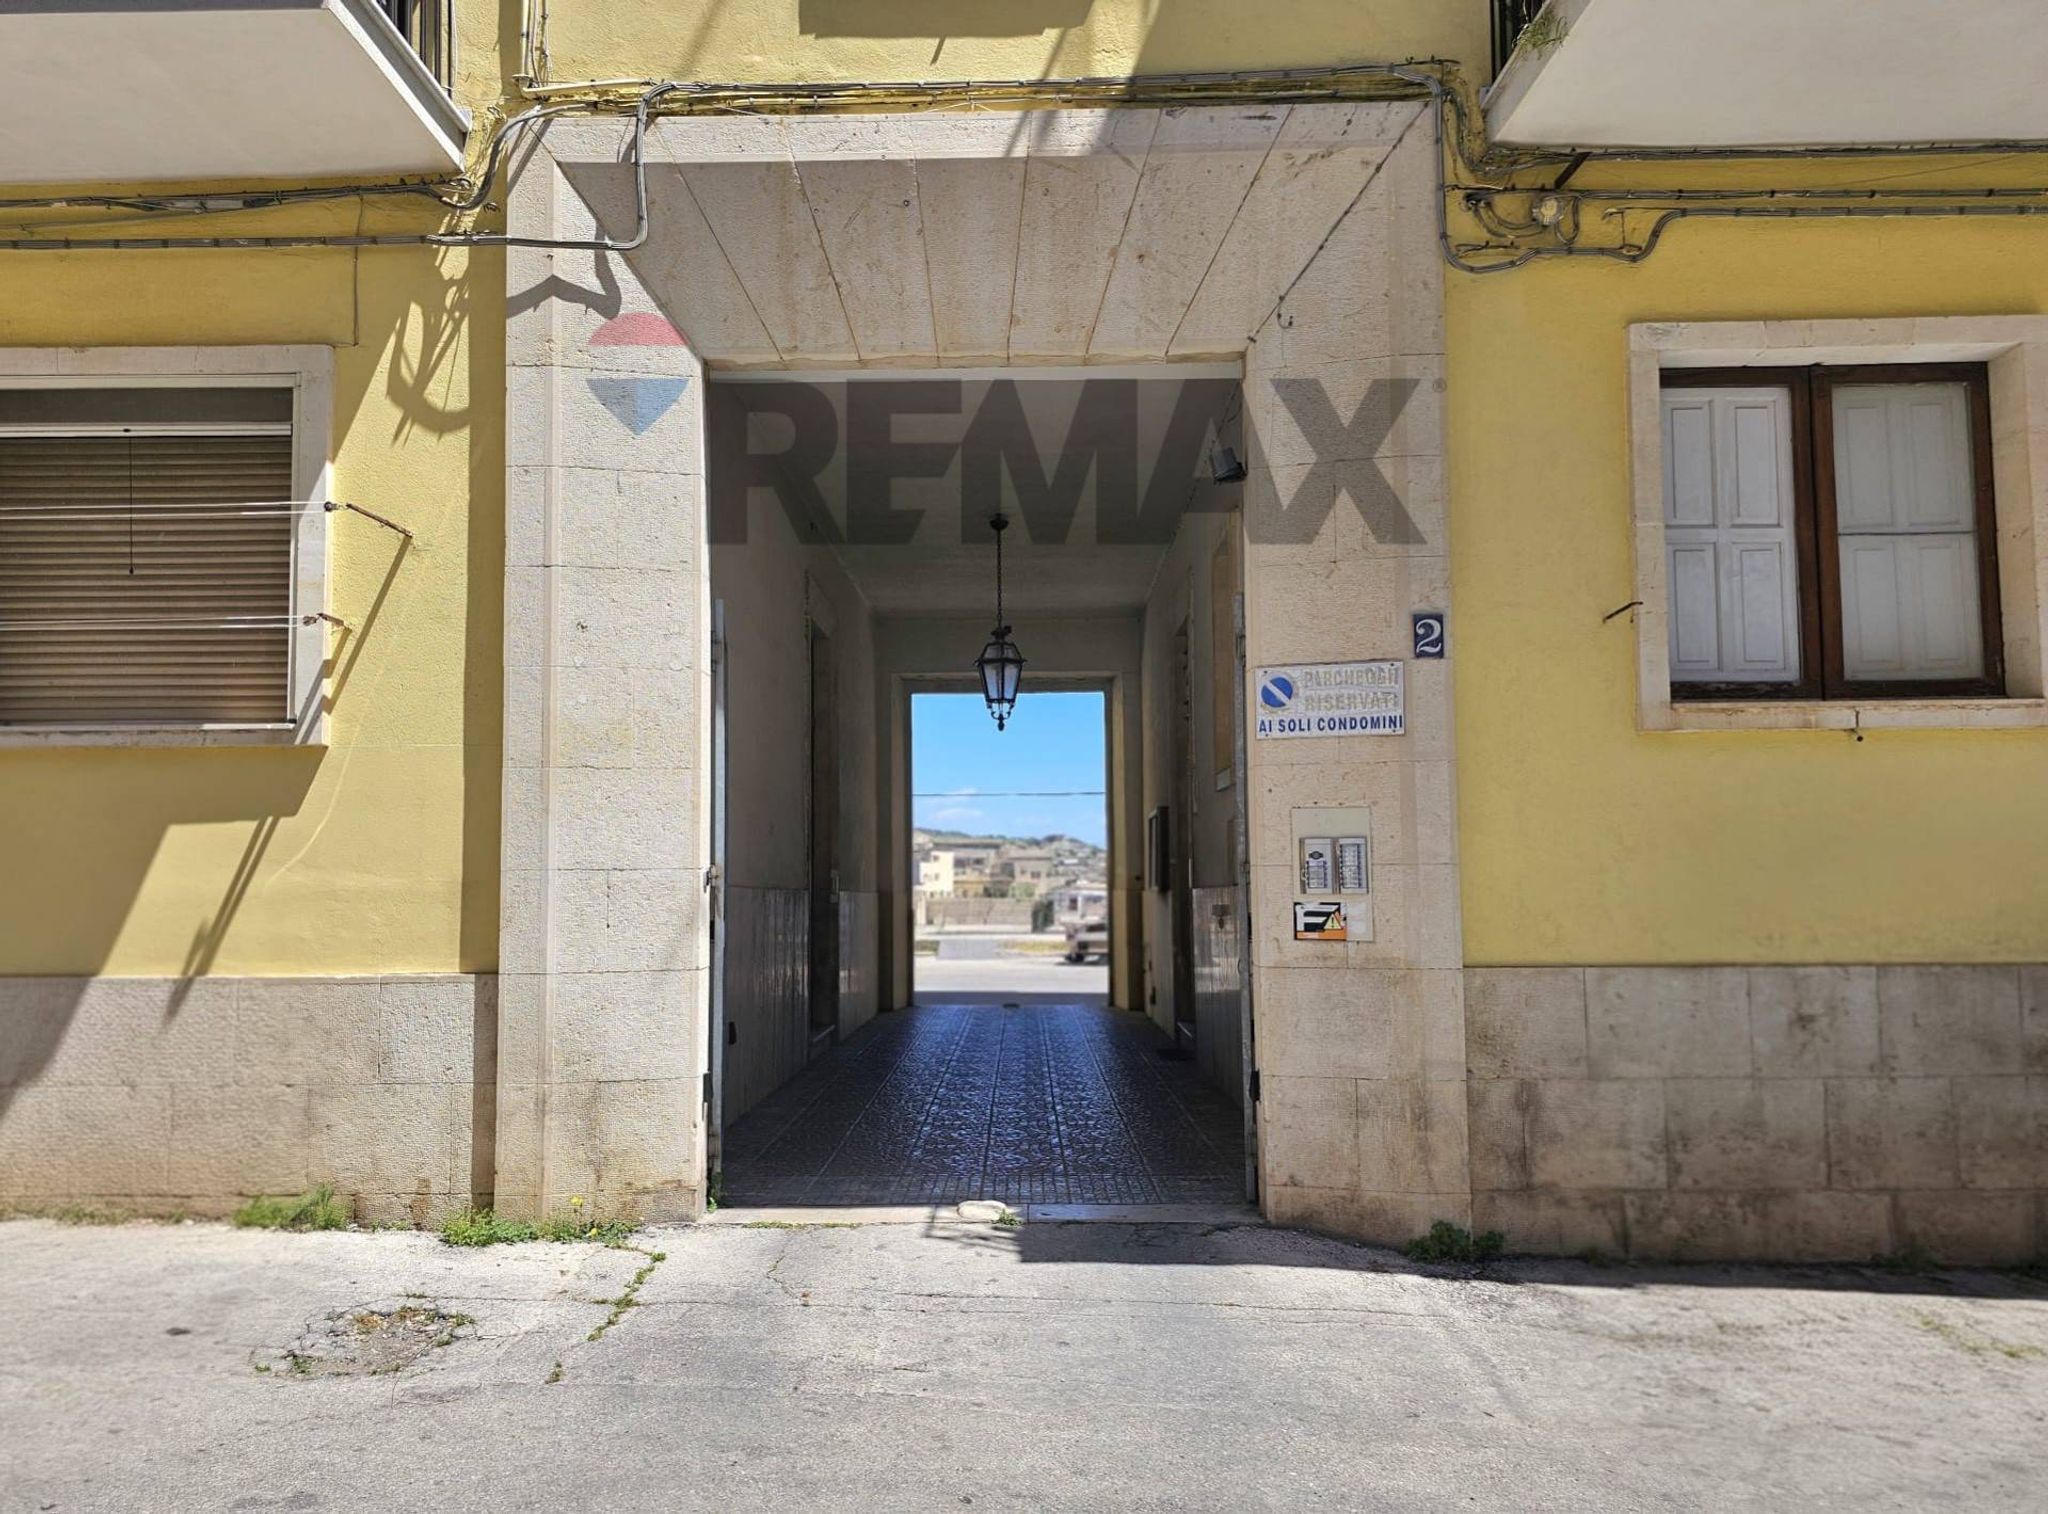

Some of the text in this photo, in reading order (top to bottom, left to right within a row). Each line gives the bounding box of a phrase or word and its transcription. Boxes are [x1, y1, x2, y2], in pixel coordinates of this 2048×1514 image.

[1415, 618, 1442, 654] 2
[1258, 715, 1403, 733] AI SOLI CONDOMINI
